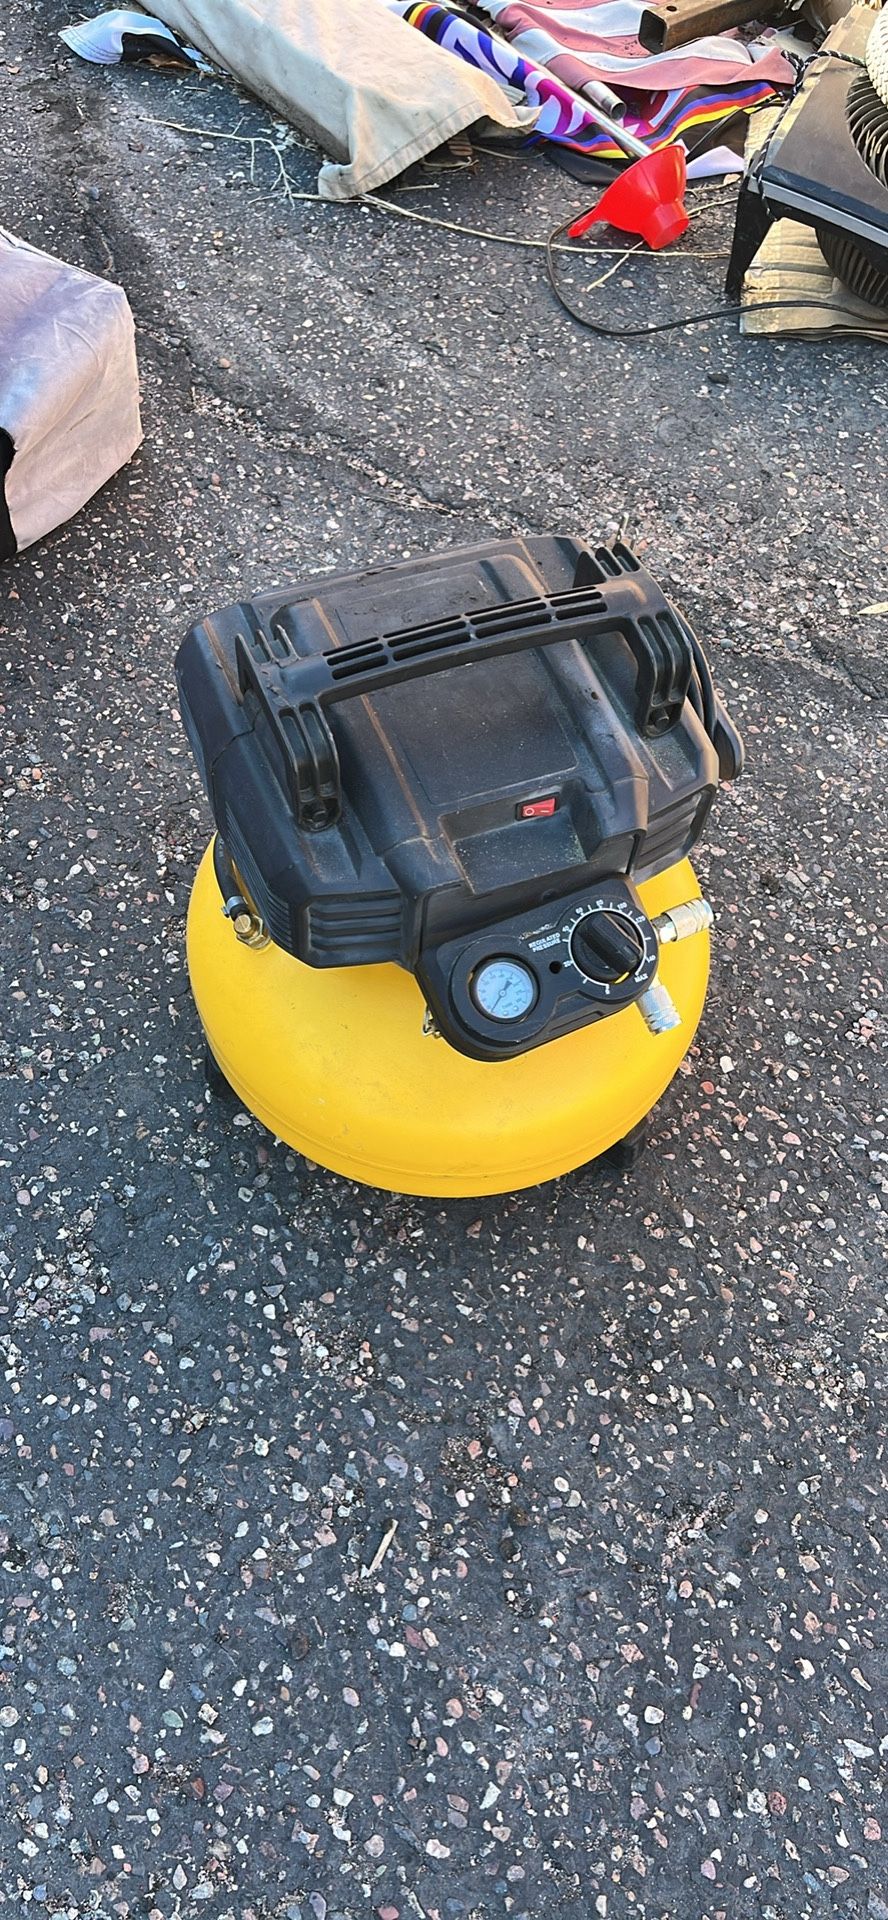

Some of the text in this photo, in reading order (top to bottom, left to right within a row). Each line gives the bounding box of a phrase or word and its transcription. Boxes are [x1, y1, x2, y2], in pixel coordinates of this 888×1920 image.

[529, 932, 560, 949] REGULATED
[532, 939, 561, 952] PRESSURE
[634, 974, 648, 983] MAX
